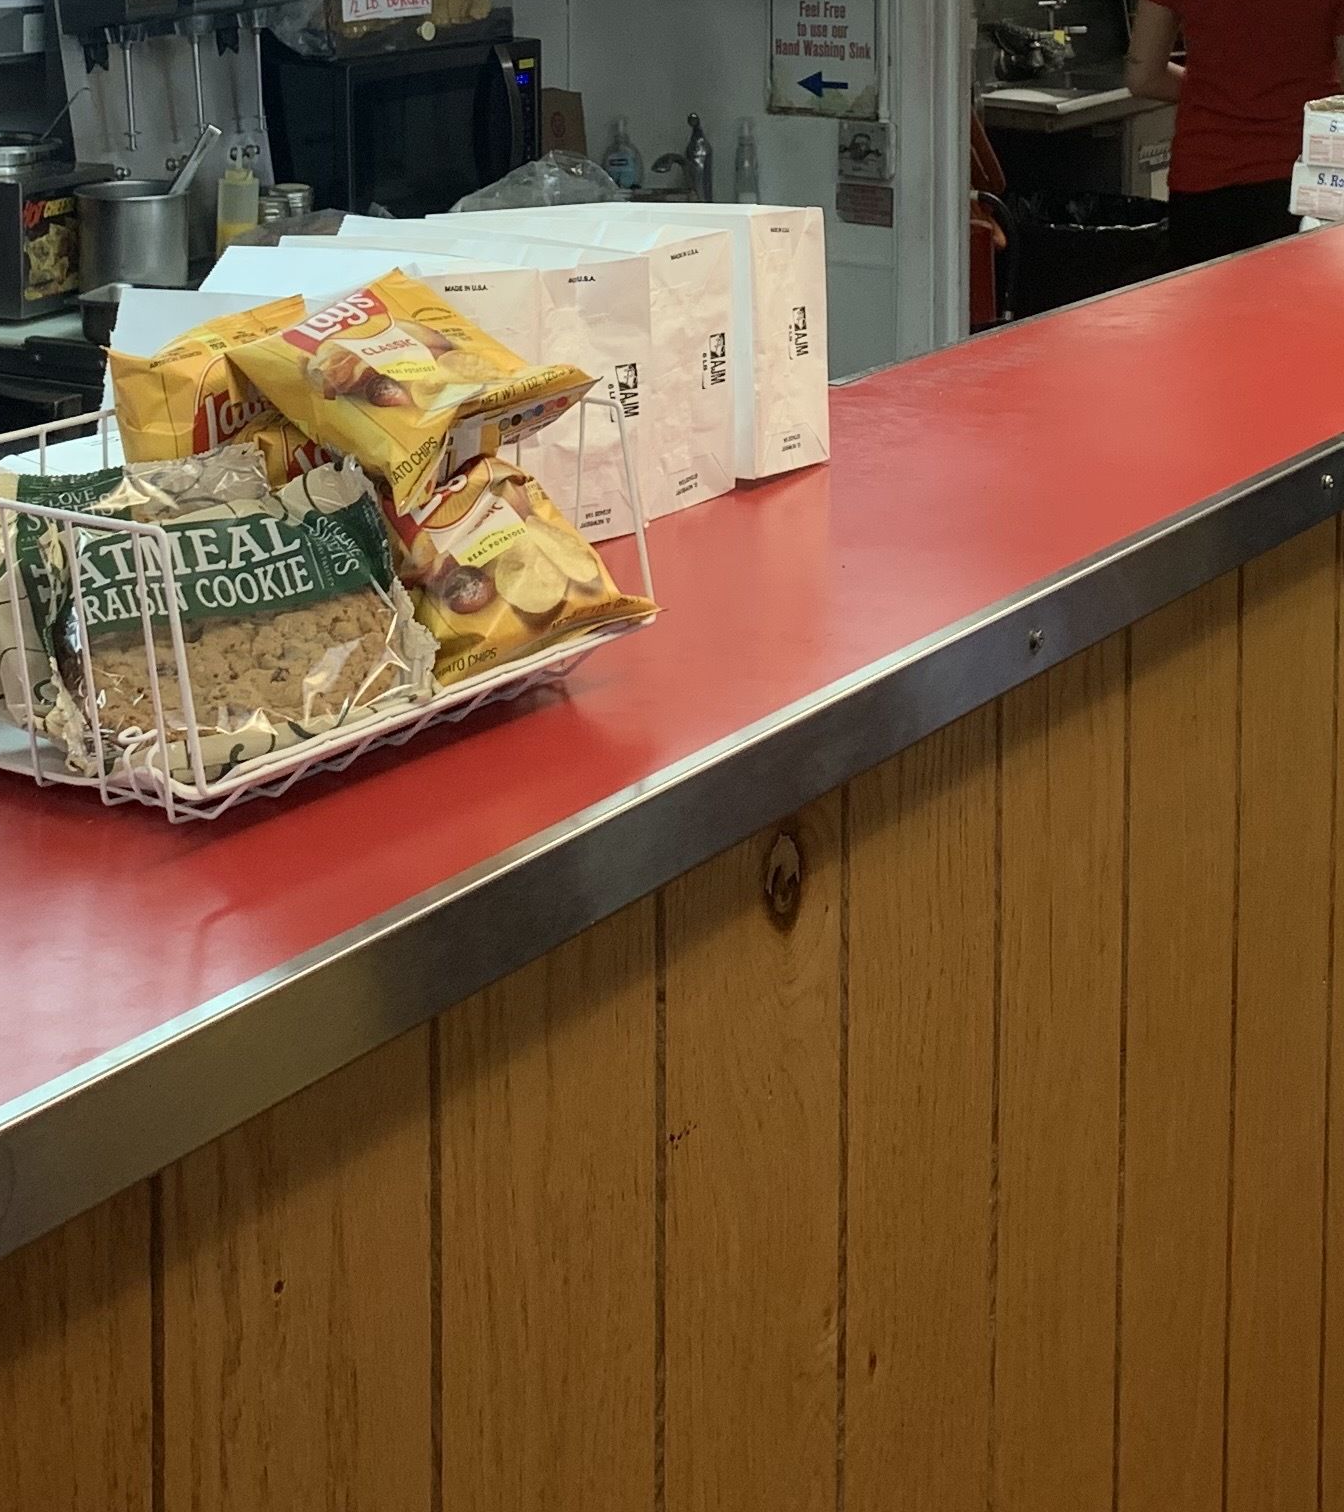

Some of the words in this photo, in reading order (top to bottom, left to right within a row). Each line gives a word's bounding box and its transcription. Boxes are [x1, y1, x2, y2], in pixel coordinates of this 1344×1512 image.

[799, 0, 820, 18] Feel
[824, 1, 846, 19] Free
[797, 21, 806, 37] to
[810, 23, 827, 38] use
[831, 24, 849, 38] our
[775, 38, 800, 56] Hand
[803, 39, 845, 61] Washing
[849, 42, 872, 59] Sink
[444, 285, 465, 293] MADE
[360, 338, 418, 357] CLASSIC
[792, 327, 810, 358] AJM
[710, 359, 726, 387] AJM
[481, 390, 500, 410] NET
[500, 384, 517, 402] WT
[618, 387, 640, 419] AJM
[409, 437, 439, 465] CHIPS
[466, 546, 488, 563] REAL
[84, 580, 189, 626] RAISIN
[195, 555, 314, 610] COOKIE
